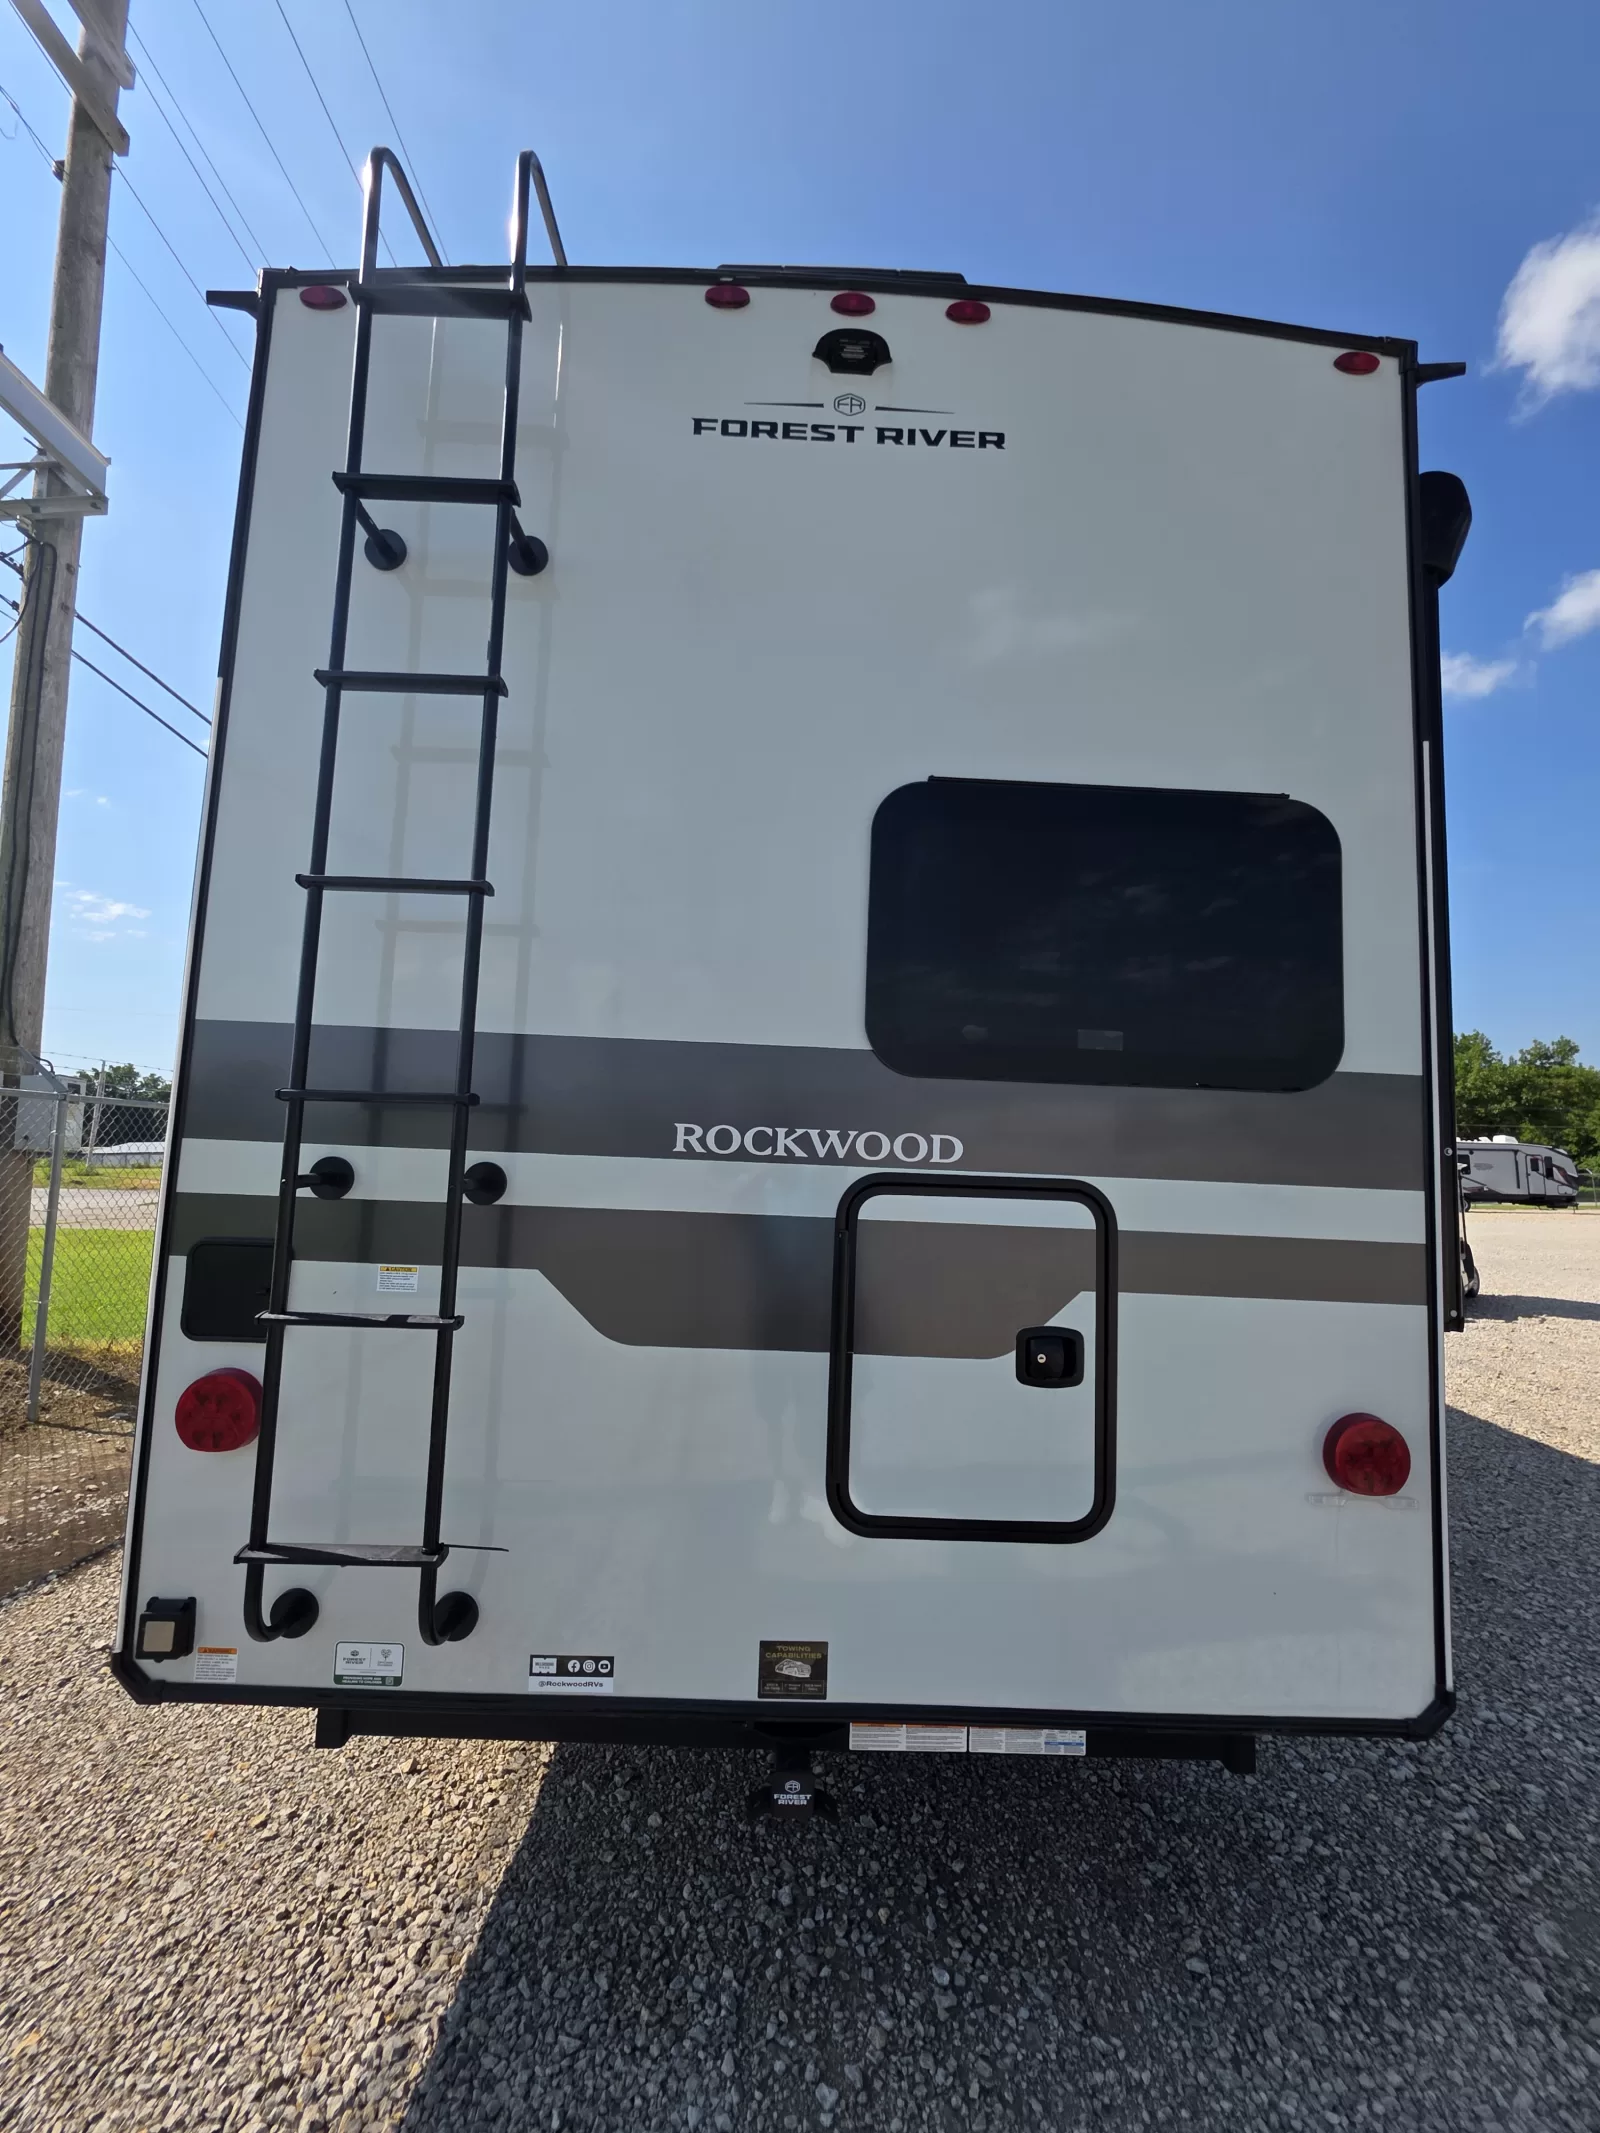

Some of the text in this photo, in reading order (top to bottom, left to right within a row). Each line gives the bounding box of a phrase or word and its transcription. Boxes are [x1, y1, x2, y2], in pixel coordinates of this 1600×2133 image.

[691, 417, 1006, 450] FOREST RIVER
[672, 1123, 964, 1163] ROCKWOOD
